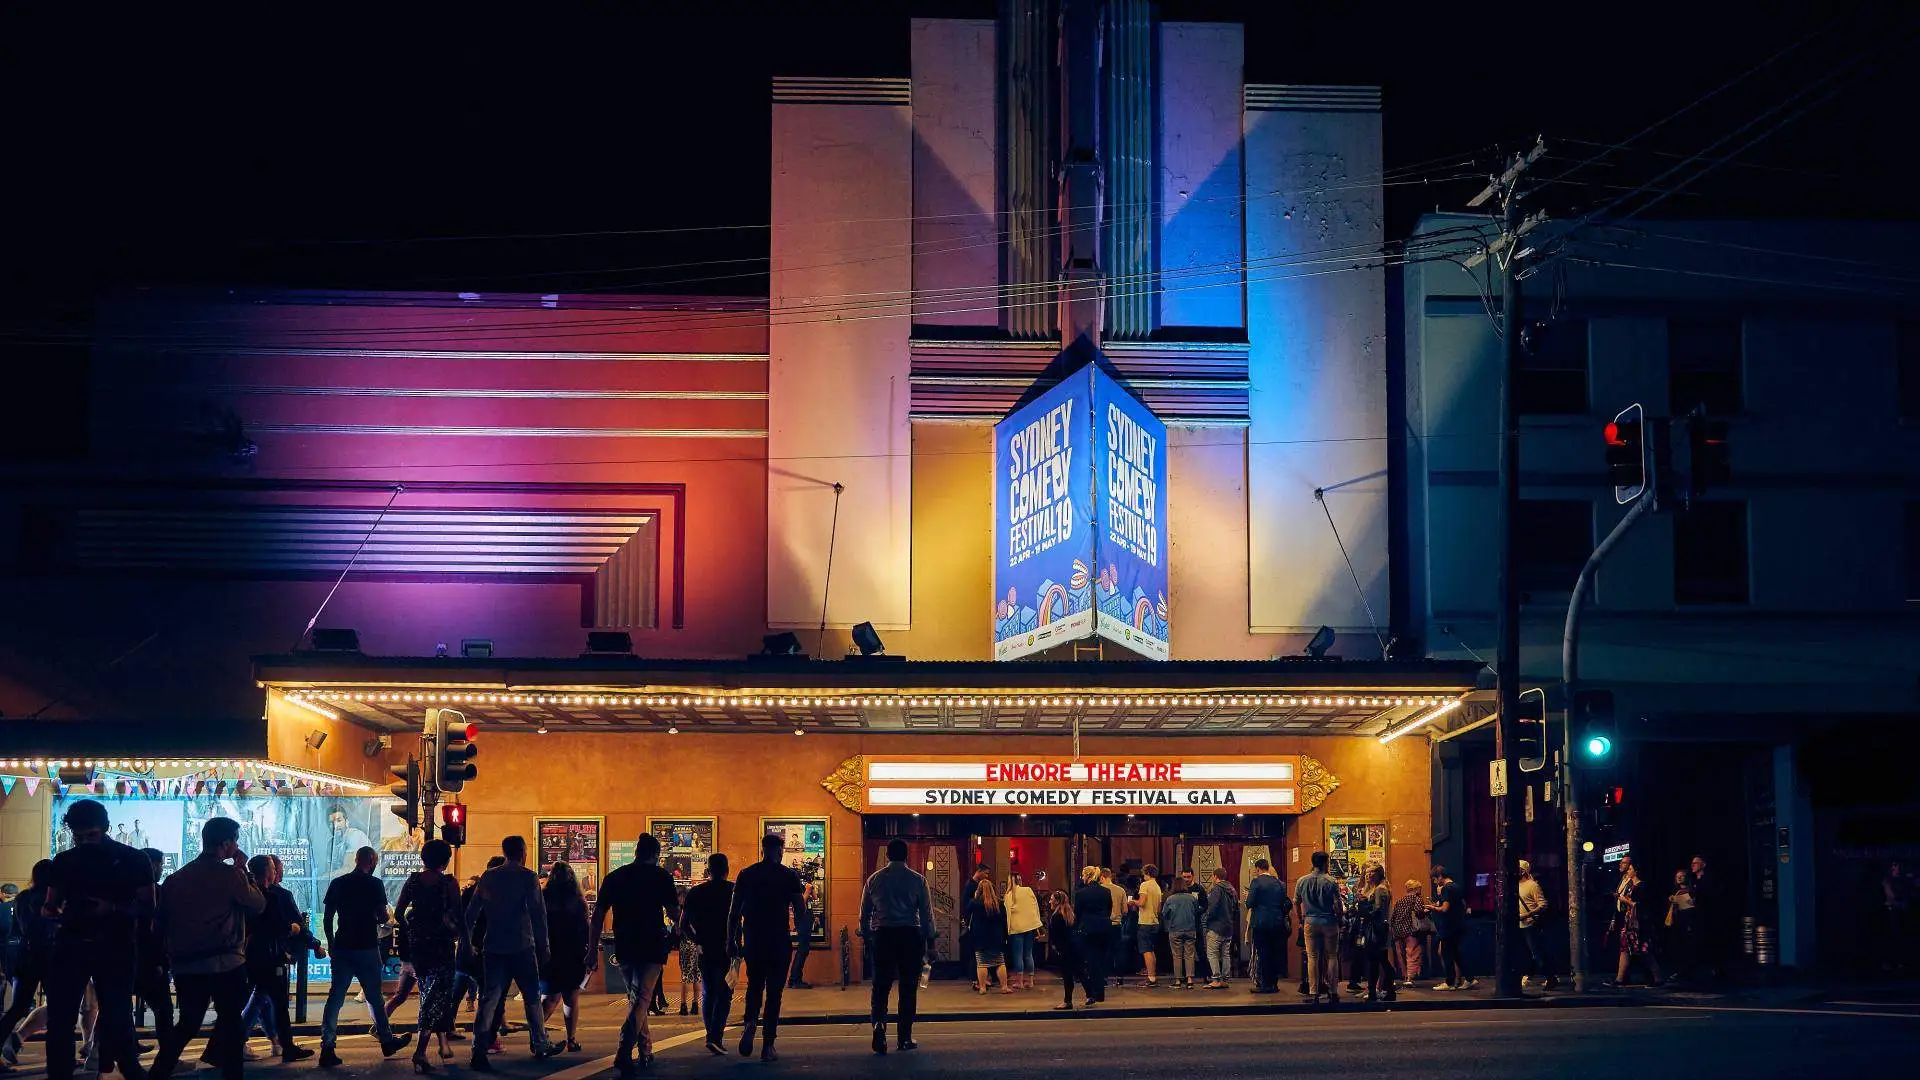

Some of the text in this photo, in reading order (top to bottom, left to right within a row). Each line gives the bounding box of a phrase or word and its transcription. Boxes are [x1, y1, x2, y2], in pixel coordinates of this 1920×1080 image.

[1010, 398, 1073, 480] SYDNEY
[1107, 402, 1156, 479] SYDNEY
[1010, 448, 1073, 525] COMEDY
[1108, 450, 1156, 525] COMEDY
[1009, 496, 1073, 556] FESTIVAL 19
[1009, 555, 1018, 567] 22
[1018, 549, 1030, 563] APR
[1041, 536, 1057, 551] MAY
[1109, 497, 1157, 567] FESTIVAL 19
[925, 790, 1237, 805] SYDNEY COMEDY FESTIVAL GALA
[986, 763, 1182, 782] ENMORE THEATRE
[279, 847, 308, 855] STEVEN
[384, 867, 405, 875] MON
